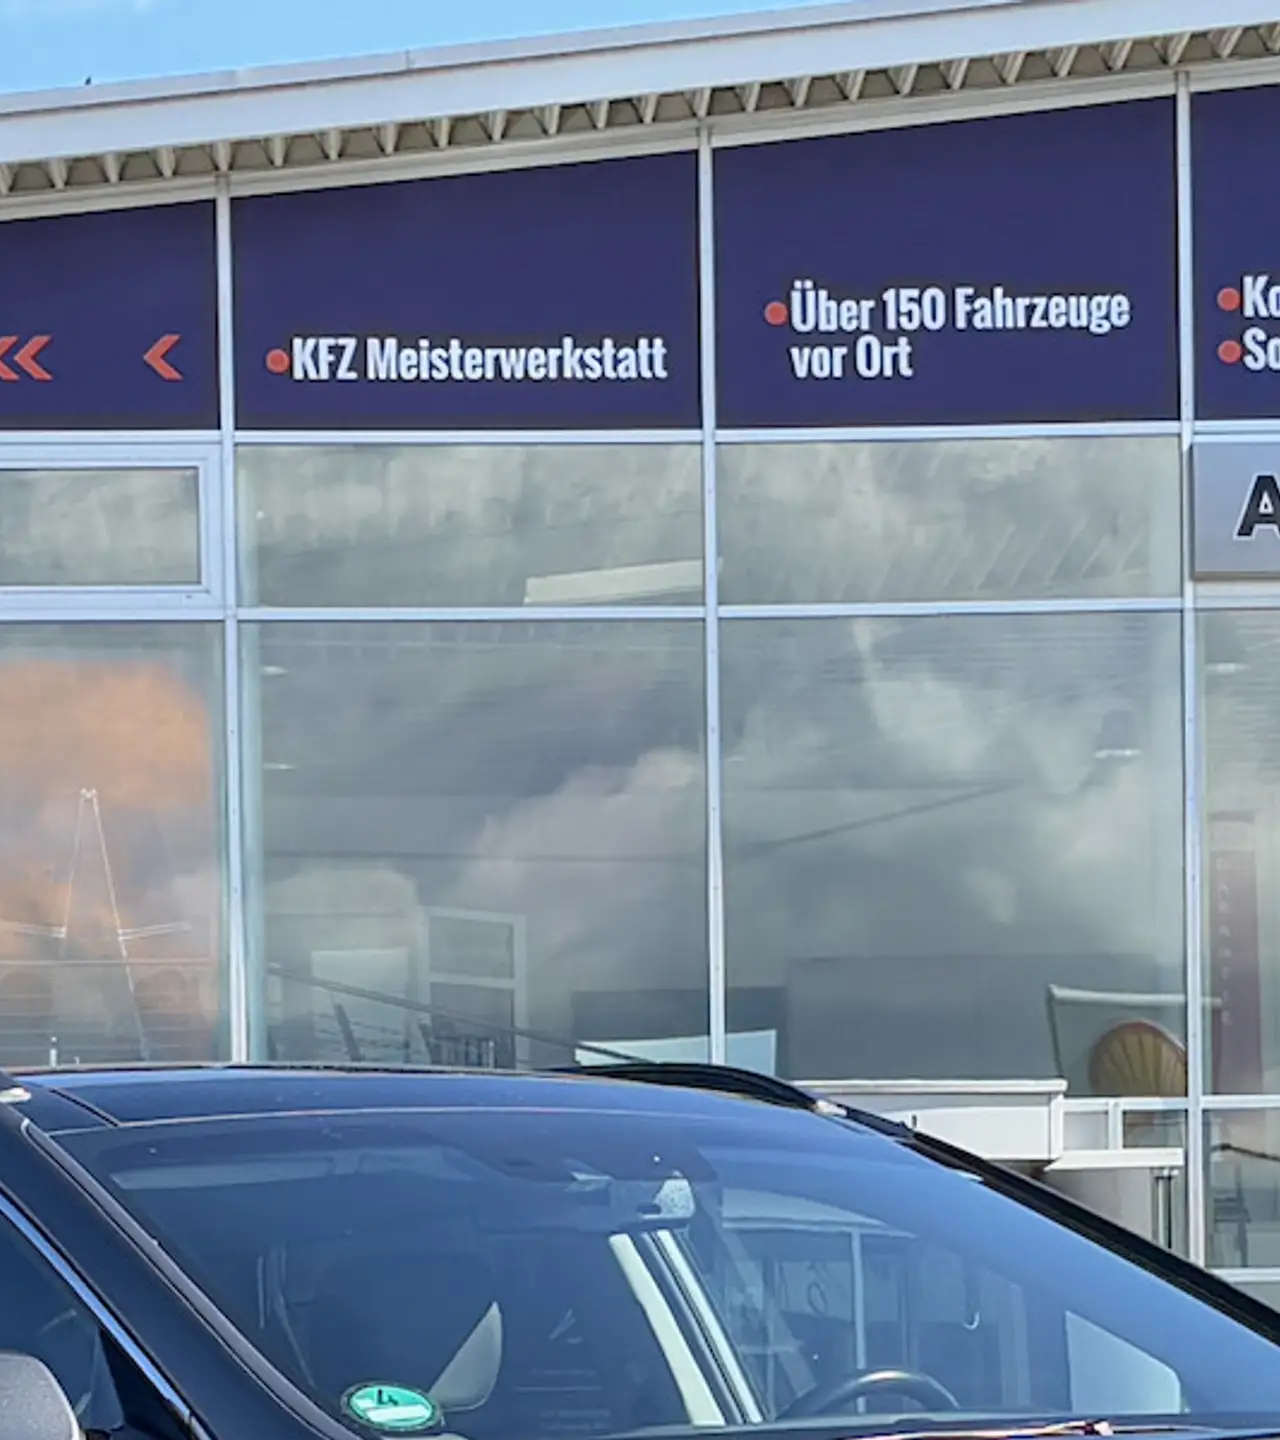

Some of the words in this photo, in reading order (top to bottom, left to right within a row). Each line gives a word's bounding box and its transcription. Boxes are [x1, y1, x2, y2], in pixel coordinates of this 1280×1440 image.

[791, 279, 876, 337] Über
[882, 287, 946, 331] 150
[955, 286, 1131, 334] Fahrzeuge
[292, 337, 358, 380] KFZ
[366, 336, 668, 380] Meisterwerkstatt
[790, 346, 848, 378] vor
[856, 334, 913, 378] Ort
